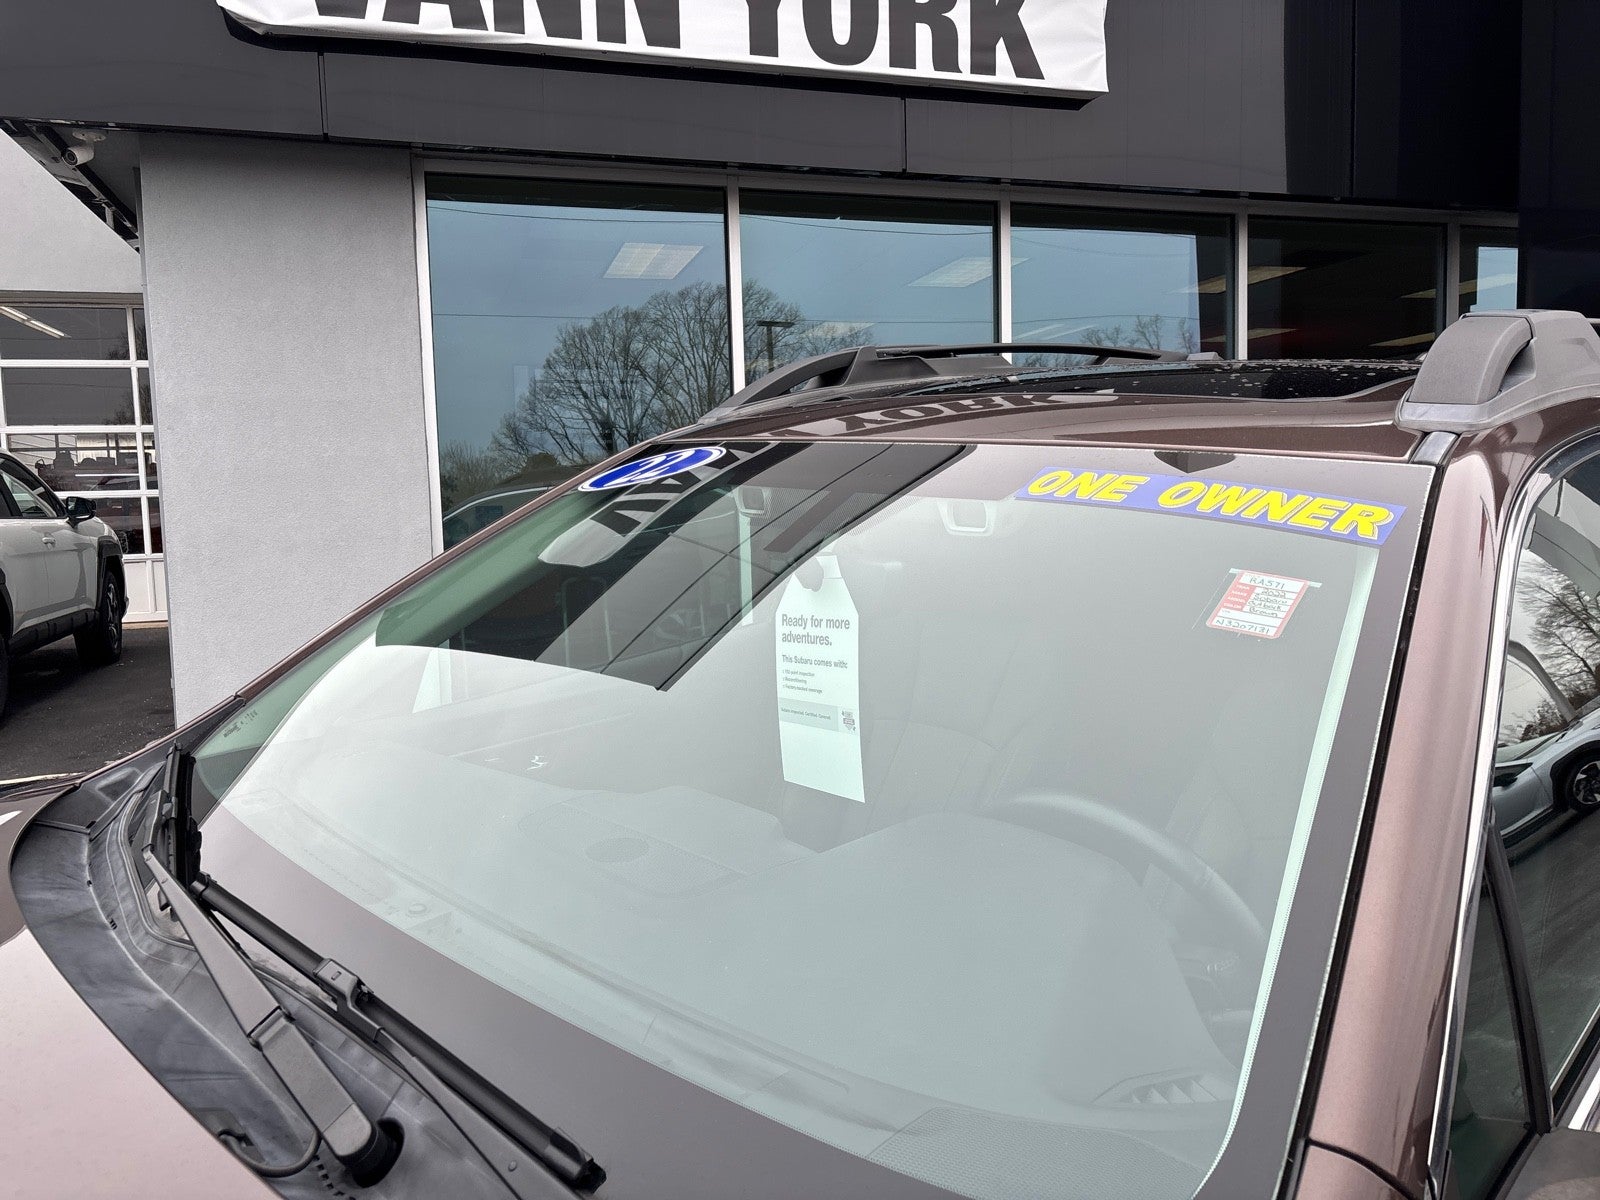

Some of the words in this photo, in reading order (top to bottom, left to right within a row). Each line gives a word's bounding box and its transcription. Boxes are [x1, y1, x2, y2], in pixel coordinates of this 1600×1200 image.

[603, 450, 696, 487] 22
[1028, 469, 1150, 502] ONE
[1157, 480, 1394, 540] OWNER
[1249, 576, 1285, 590] RA571
[781, 613, 808, 630] Ready
[810, 614, 823, 628] for
[825, 618, 850, 629] more
[781, 631, 832, 646] adventures.
[782, 654, 793, 663] This
[794, 655, 813, 665] Subaru
[814, 659, 832, 667] comes
[833, 659, 848, 669] with:
